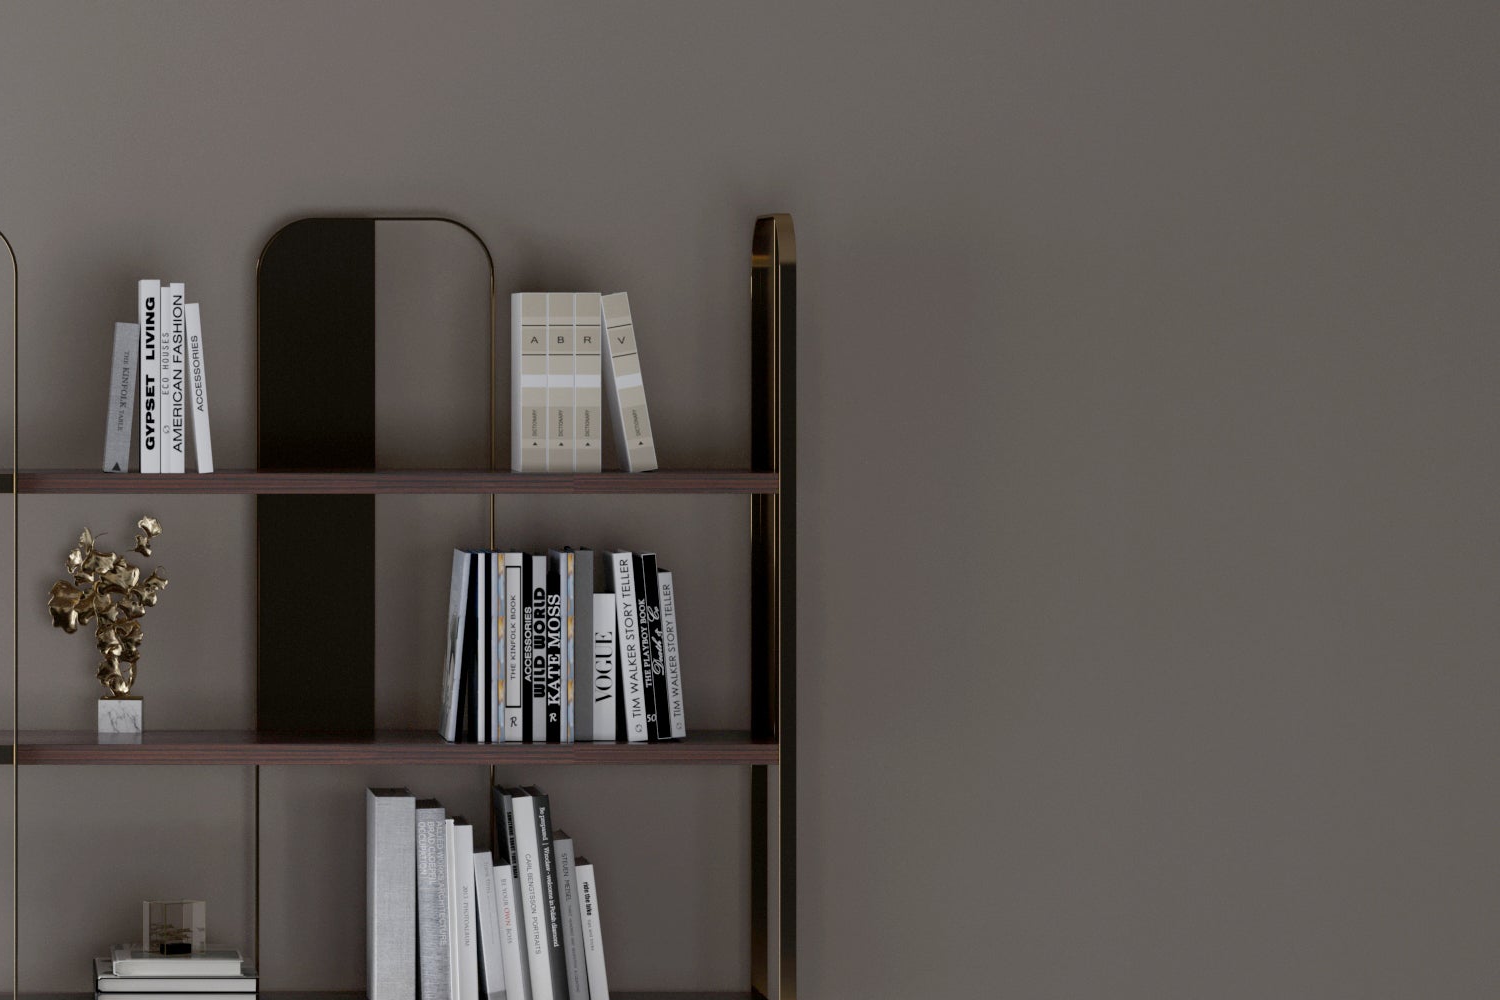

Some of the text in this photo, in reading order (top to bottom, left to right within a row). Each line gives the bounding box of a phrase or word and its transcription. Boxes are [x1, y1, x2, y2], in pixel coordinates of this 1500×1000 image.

[145, 297, 155, 450] GYPSET LIVING
[172, 295, 183, 453] AMERICAN FASHION
[190, 335, 204, 412] ACCESSORIES
[530, 336, 539, 344] A
[557, 336, 565, 344] B
[583, 336, 592, 344] R
[617, 336, 626, 345] V
[119, 367, 130, 408] KINFOLK
[524, 606, 532, 682] ACCESSORIES
[547, 594, 561, 706] KATE MOSS
[594, 631, 613, 703] VOGUE
[619, 558, 642, 718] TIM WALKER STORY TELLER
[638, 598, 653, 688] THE PLAYBOY BOOK
[662, 583, 682, 717] TIM WALKER STORY TELLER
[418, 821, 427, 876] OCCUPATION
[427, 821, 435, 844] BRAD
[436, 821, 447, 946] ALLIED WORKS ARCHITECTURE
[503, 907, 512, 926] OWN
[525, 853, 542, 955] CARL BENGTSSON PORTRAITS
